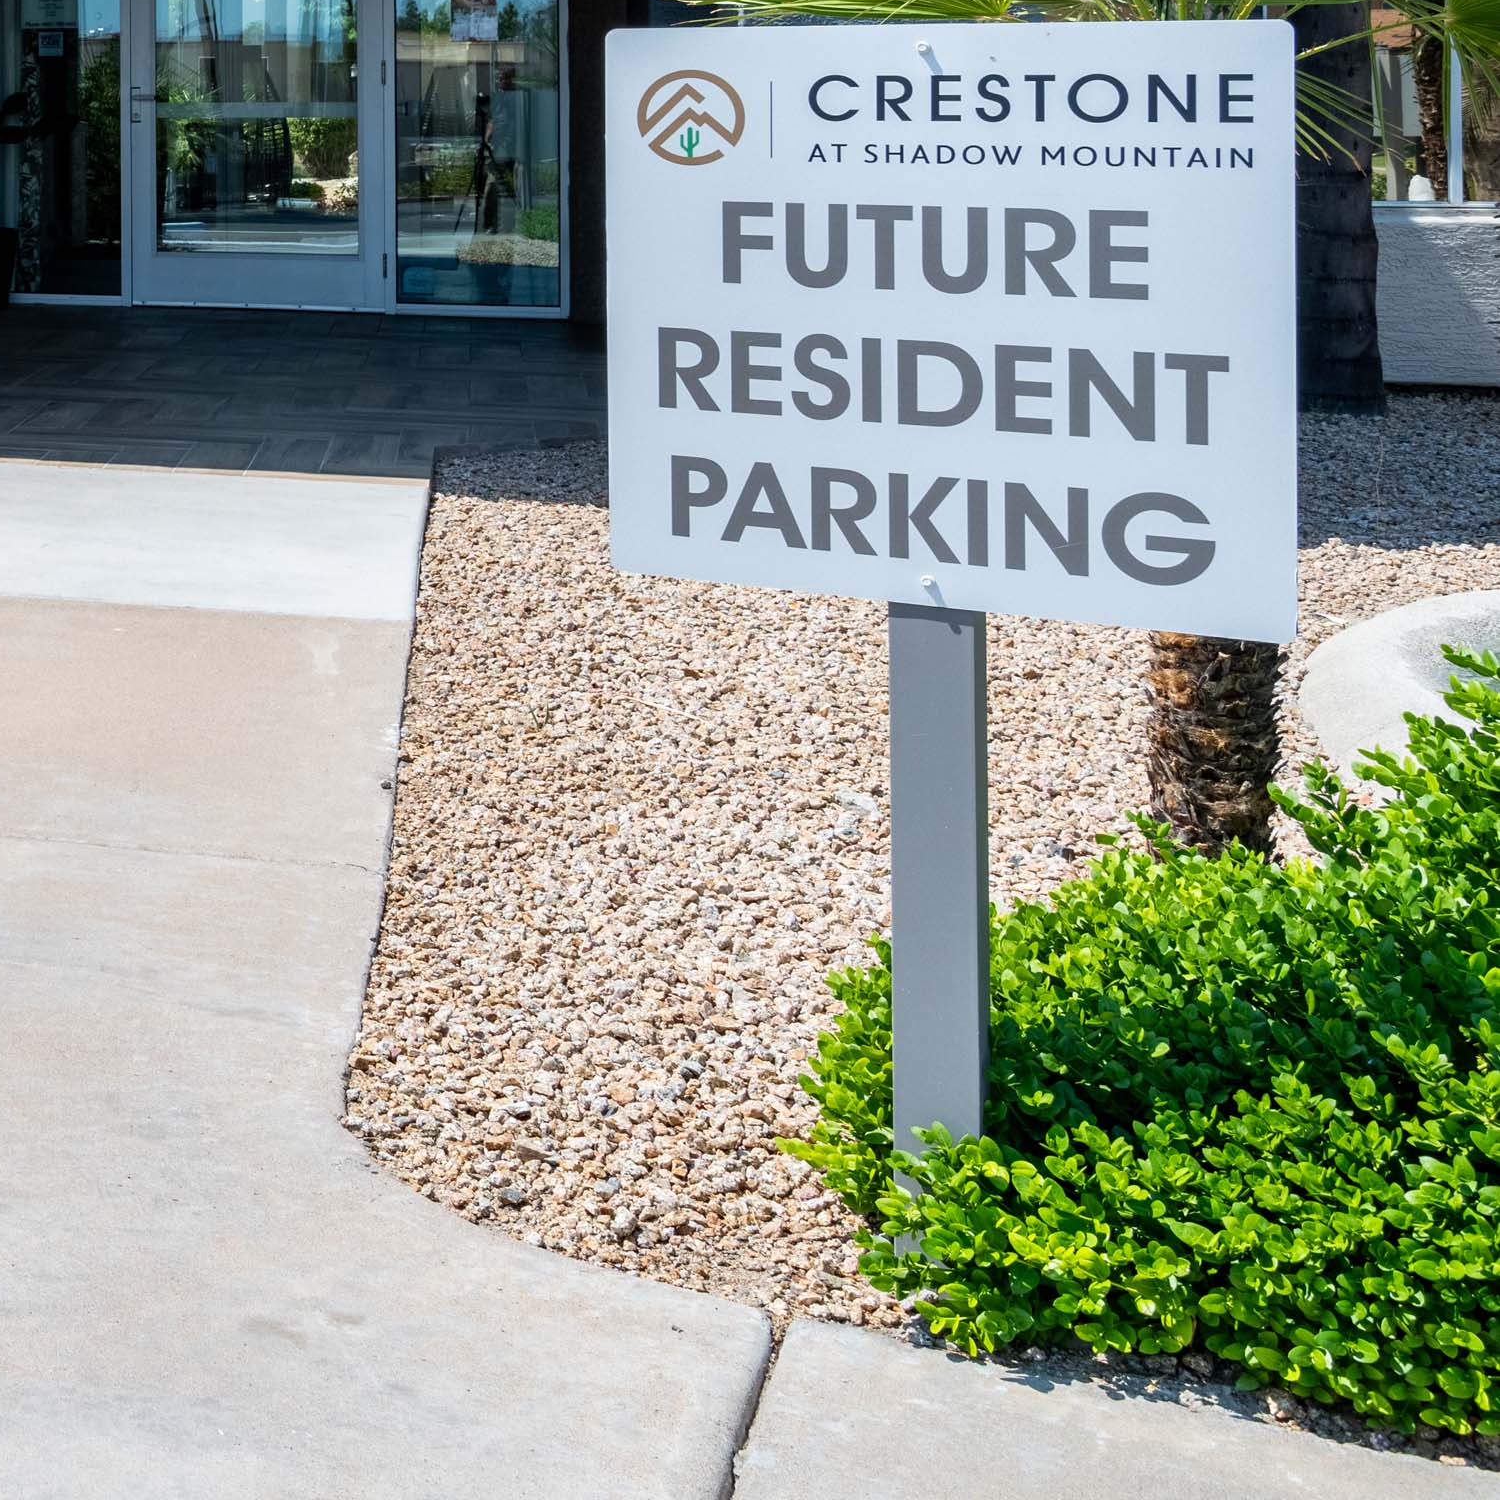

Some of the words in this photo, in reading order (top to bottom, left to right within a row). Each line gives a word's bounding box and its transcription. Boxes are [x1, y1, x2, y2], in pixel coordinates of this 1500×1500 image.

[807, 73, 1255, 124] CRESTONE
[807, 143, 848, 163] AT
[863, 143, 1023, 166] SHADOW
[1041, 145, 1254, 169] MOUNTAIN
[721, 200, 1149, 301] FUTURE
[657, 326, 1230, 446] RESIDENT
[670, 454, 1217, 587] PARKING
